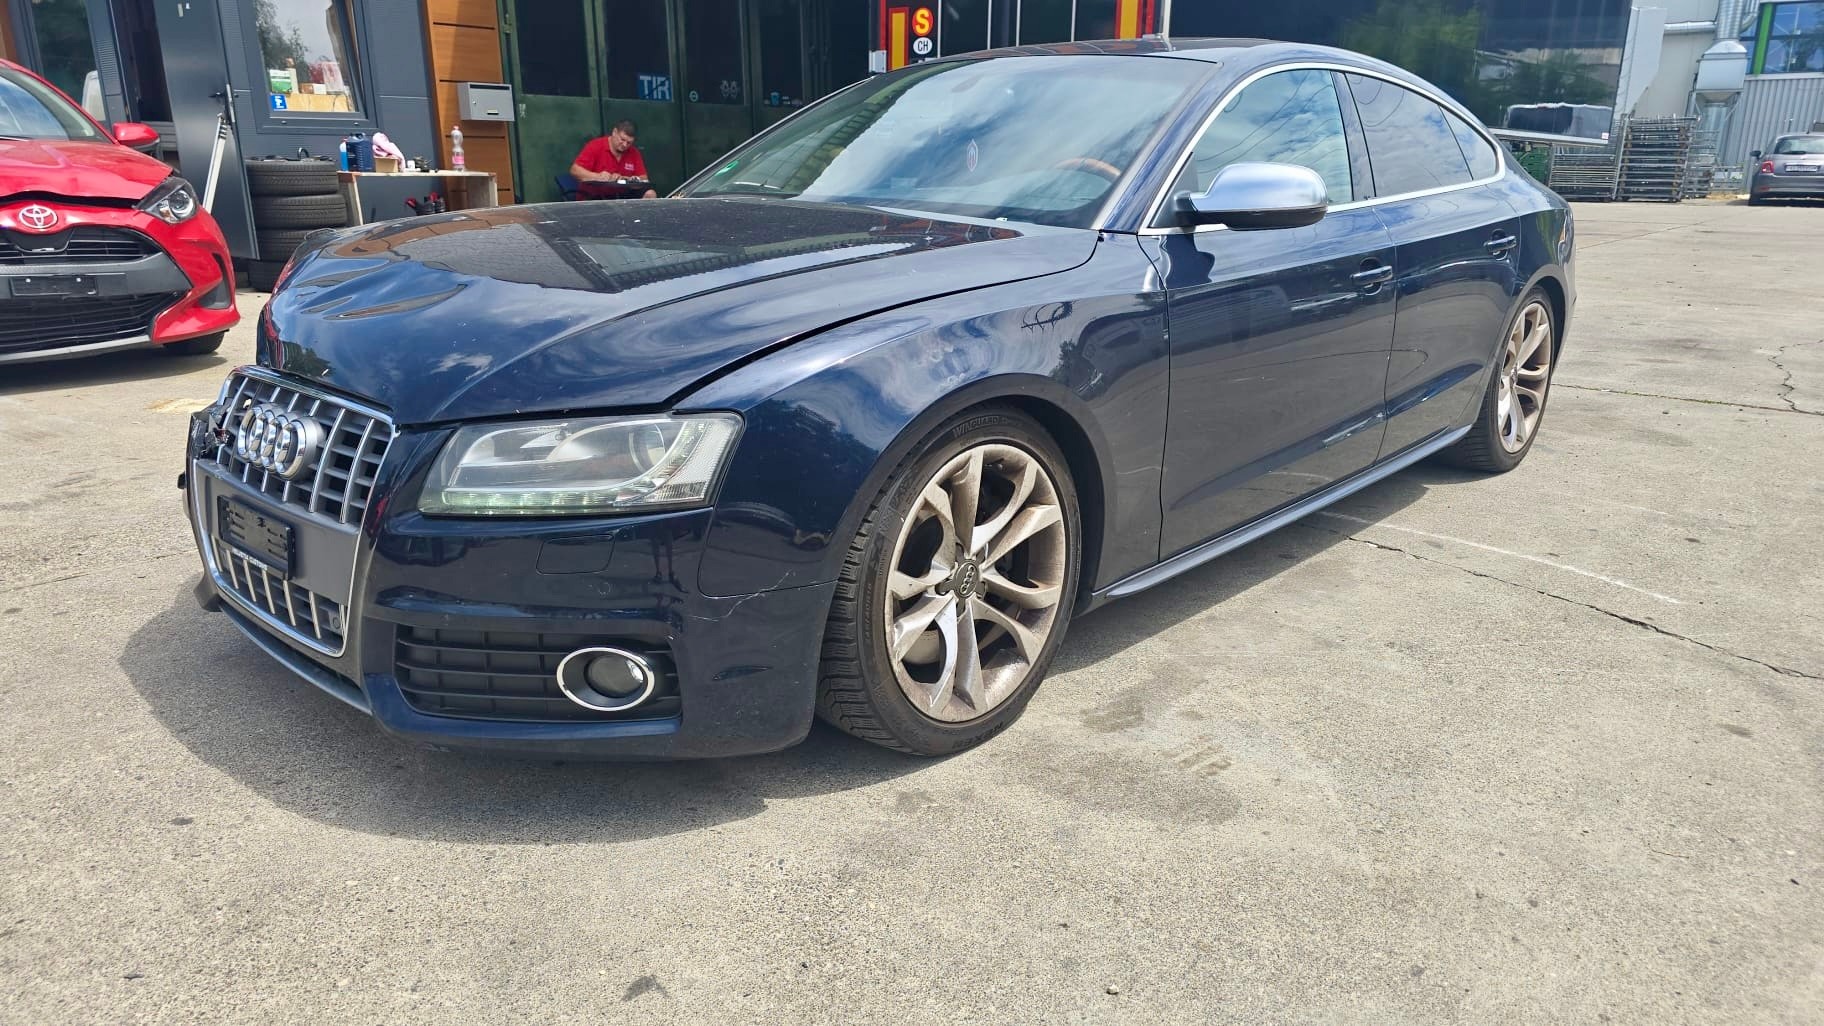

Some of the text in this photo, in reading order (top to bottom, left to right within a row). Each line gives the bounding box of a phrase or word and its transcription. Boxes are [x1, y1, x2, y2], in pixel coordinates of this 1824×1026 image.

[916, 8, 929, 34] S
[917, 40, 929, 52] CH
[639, 75, 671, 100] TIR
